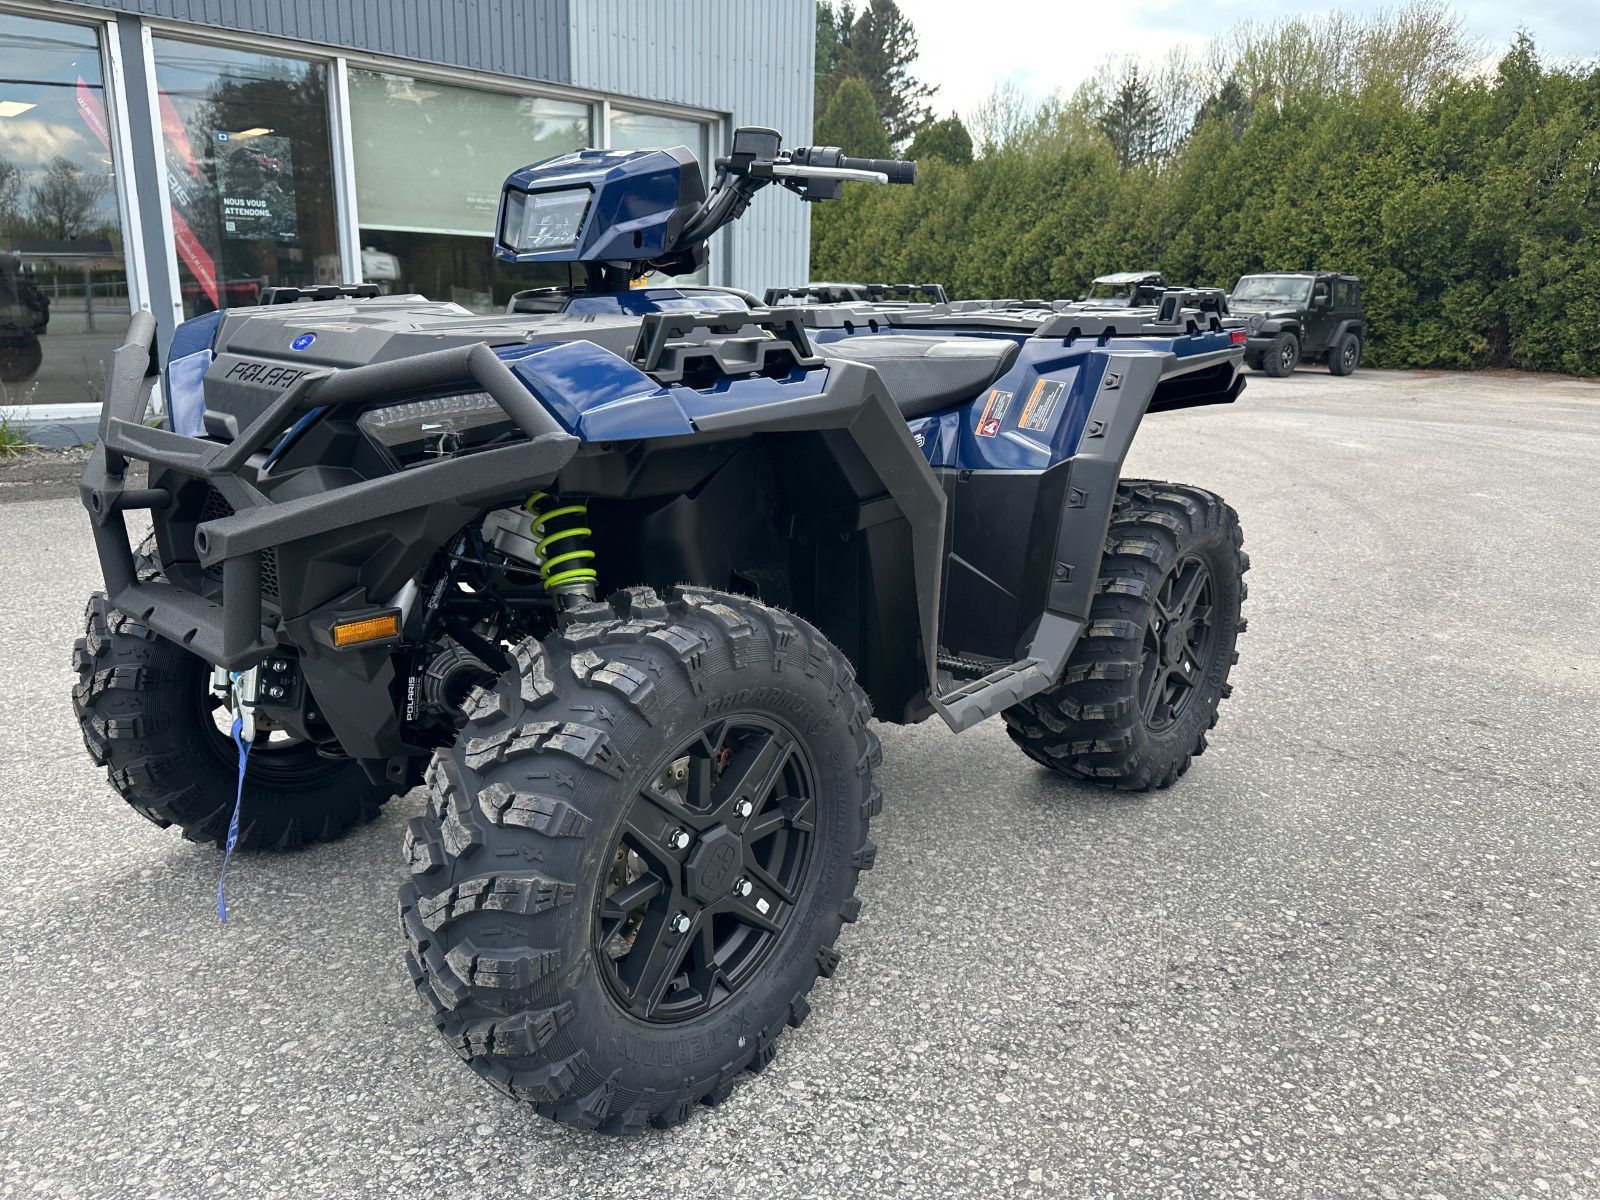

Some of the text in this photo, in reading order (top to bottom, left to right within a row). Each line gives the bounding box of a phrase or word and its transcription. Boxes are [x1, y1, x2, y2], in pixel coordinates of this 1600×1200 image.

[223, 197, 267, 208] NOUS VOUS
[225, 207, 272, 217] ATTENDONS.
[406, 676, 415, 721] POLARIS
